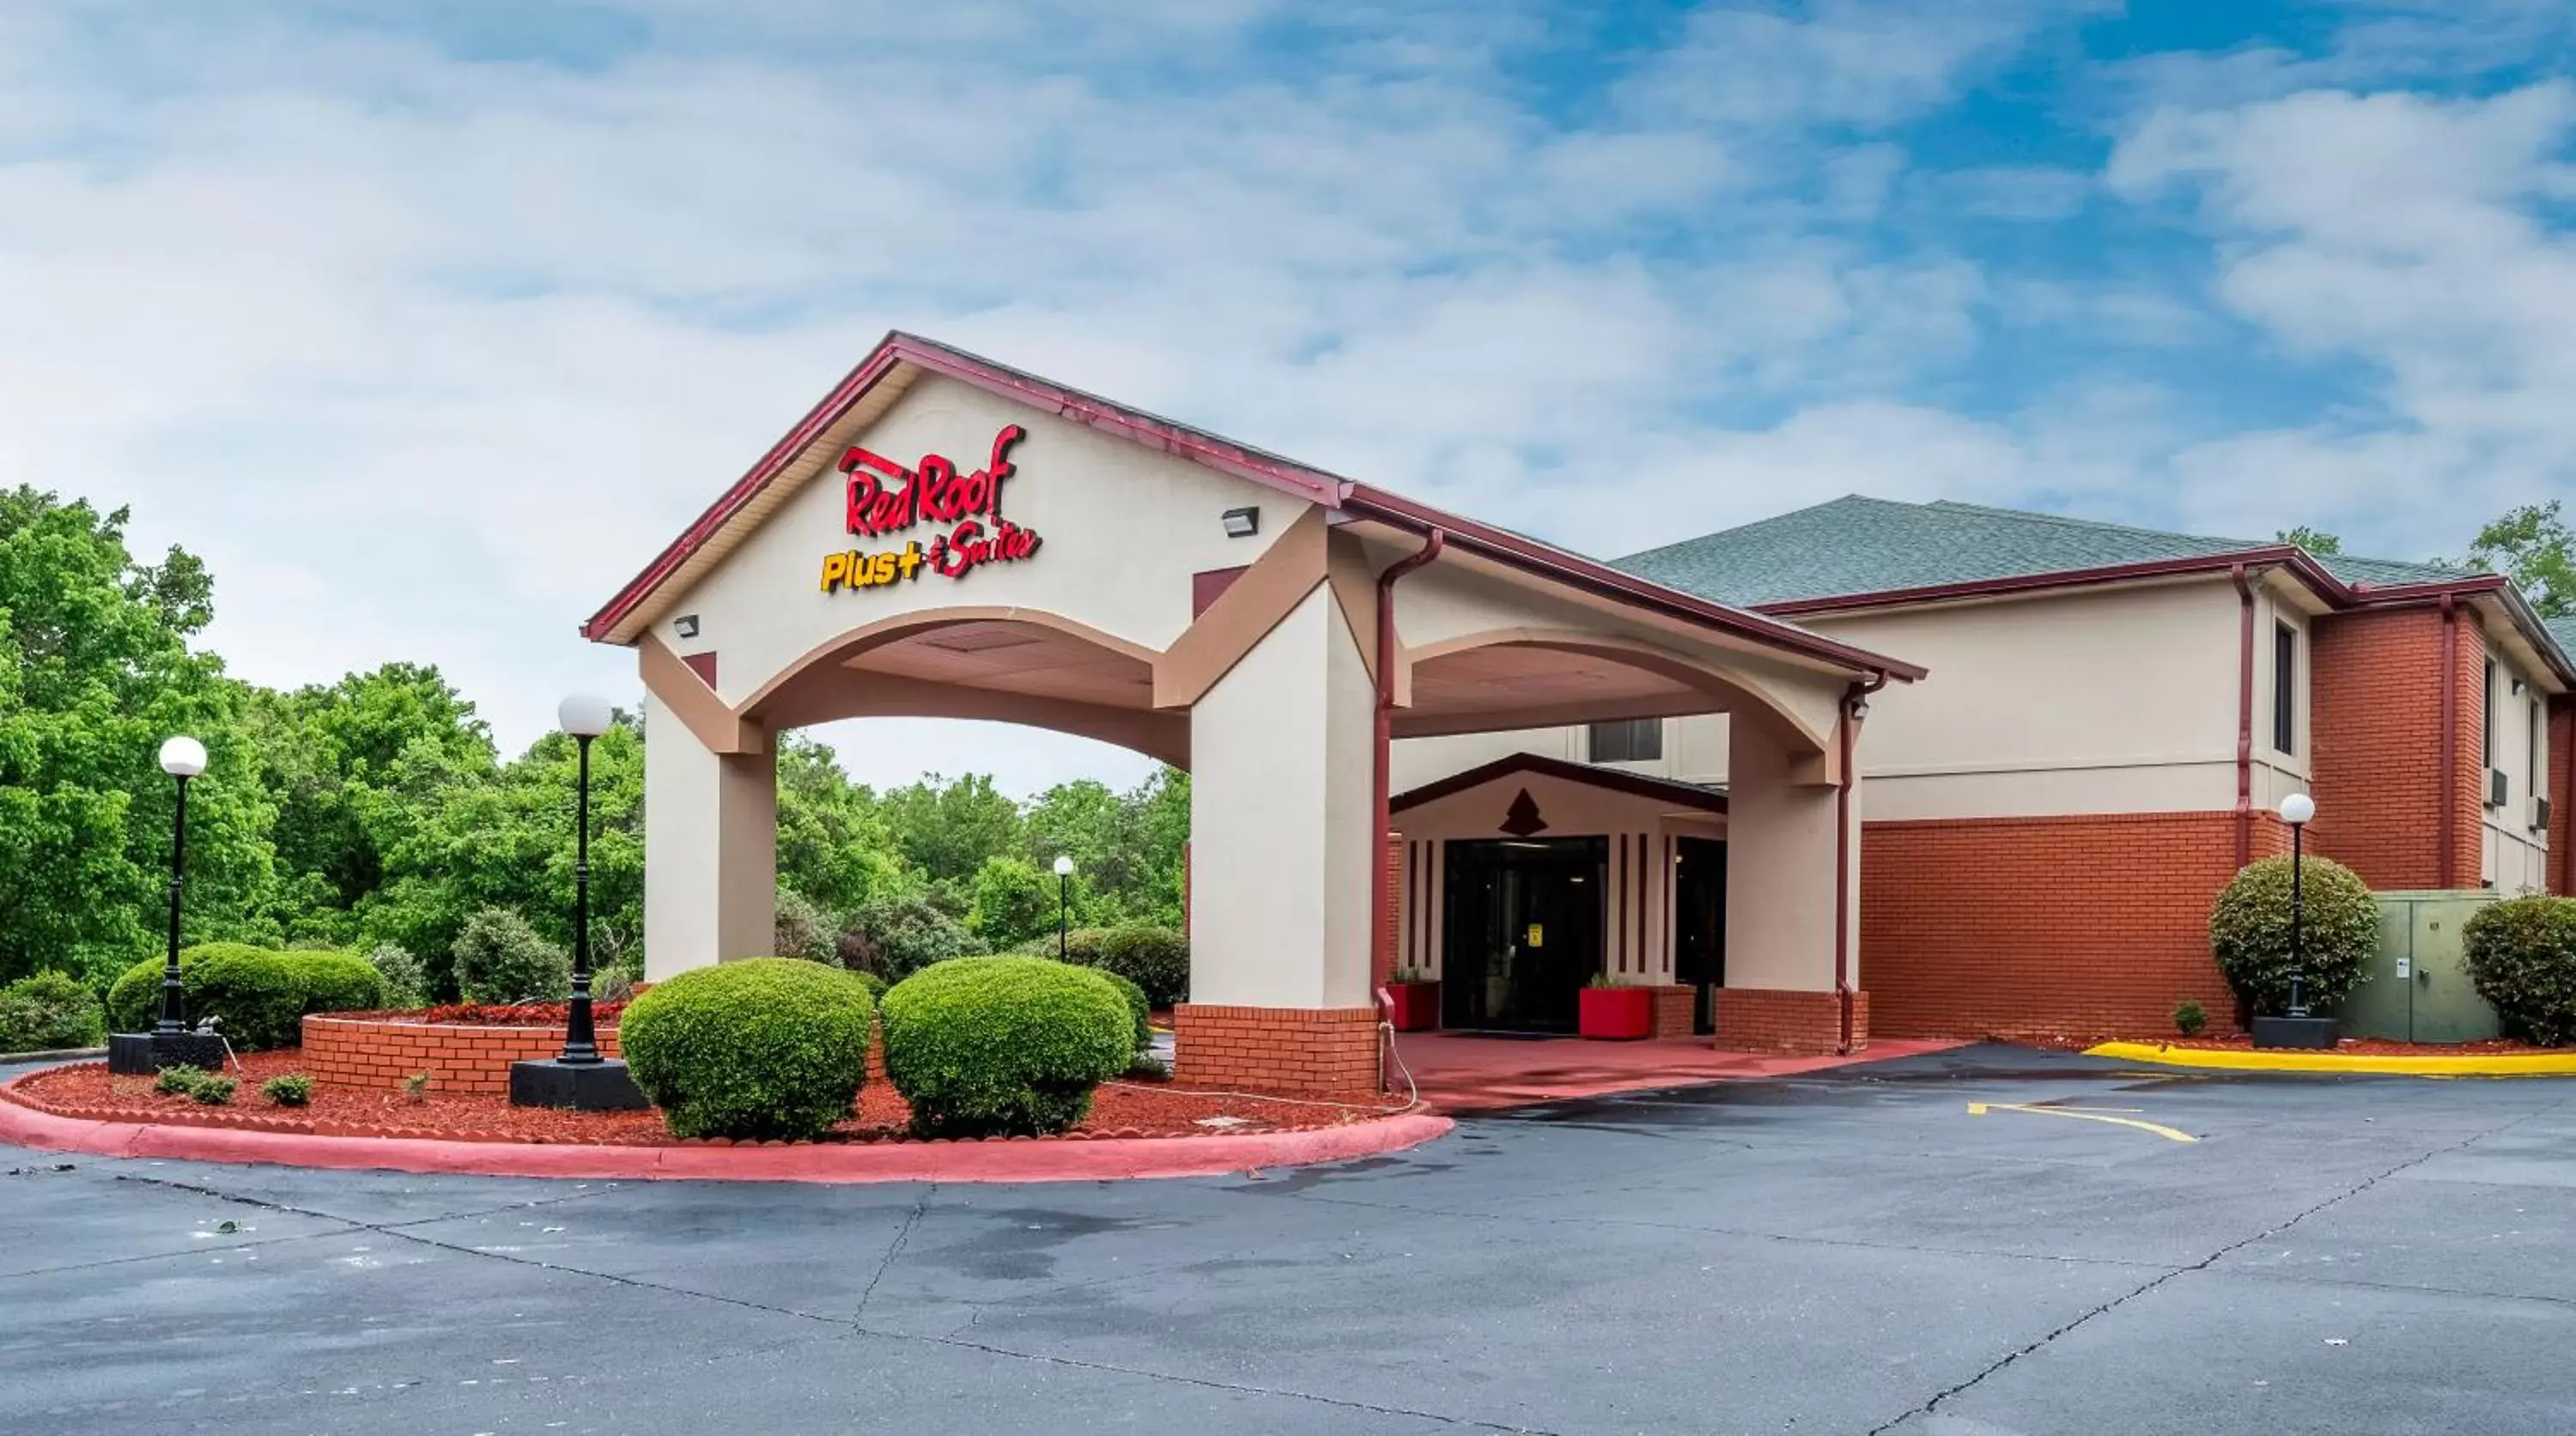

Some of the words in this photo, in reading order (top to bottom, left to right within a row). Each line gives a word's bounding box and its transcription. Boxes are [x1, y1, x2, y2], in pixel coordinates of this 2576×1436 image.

[846, 471, 916, 537] Red
[919, 424, 1026, 522] Roof
[945, 519, 1042, 578] Suites
